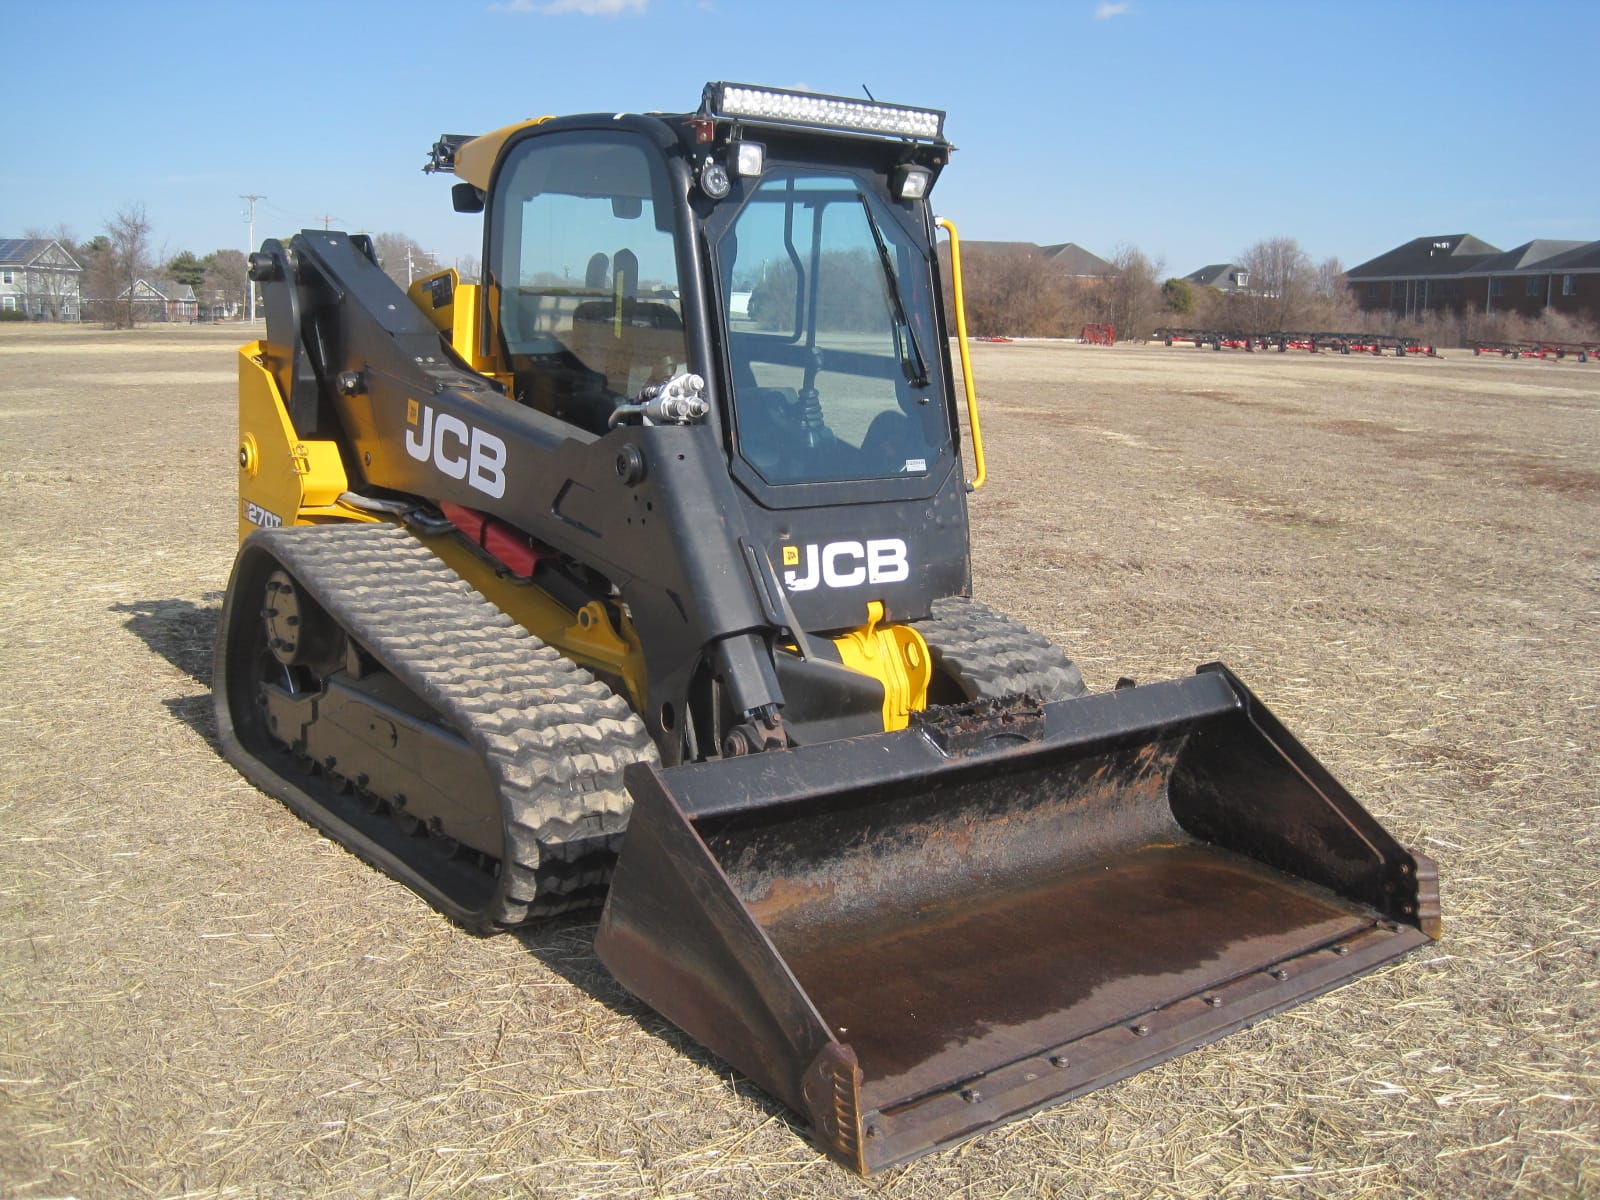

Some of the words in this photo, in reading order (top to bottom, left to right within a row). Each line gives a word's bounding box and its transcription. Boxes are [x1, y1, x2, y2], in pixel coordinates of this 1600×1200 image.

[405, 404, 507, 499] JCB
[248, 502, 282, 528] 270T
[783, 538, 910, 592] JCB
